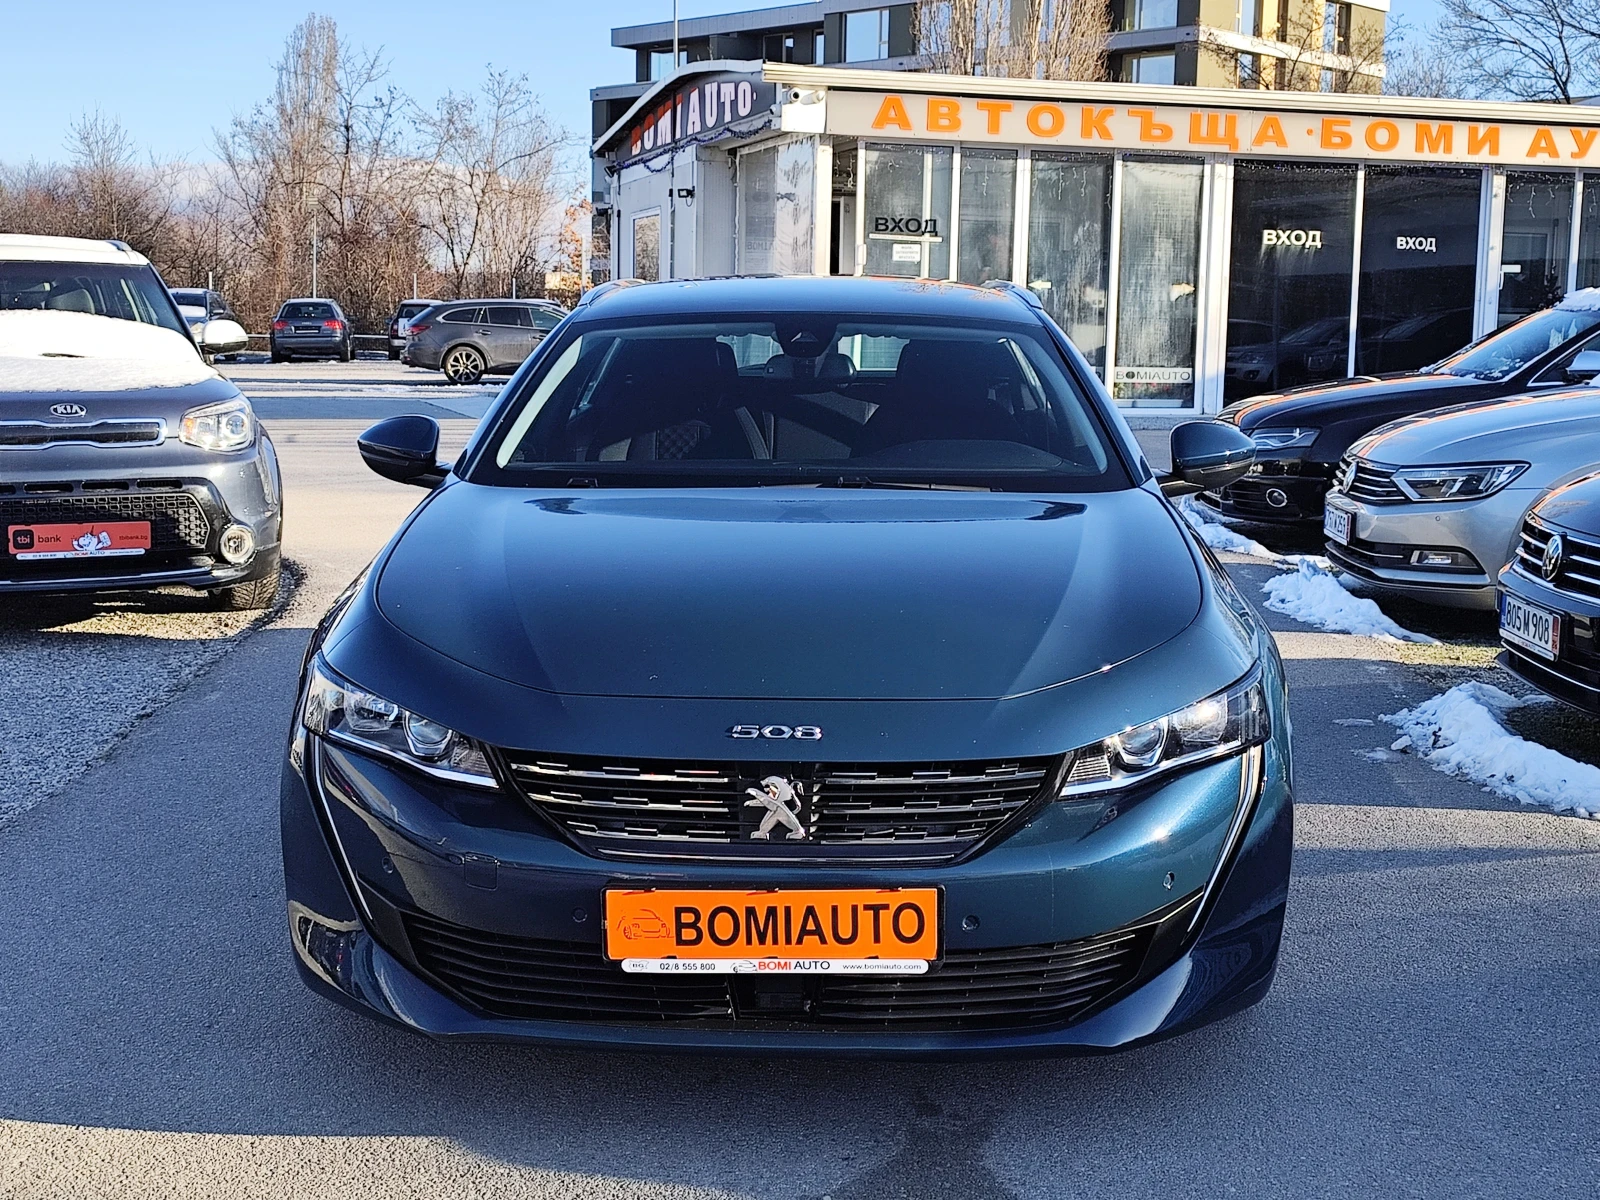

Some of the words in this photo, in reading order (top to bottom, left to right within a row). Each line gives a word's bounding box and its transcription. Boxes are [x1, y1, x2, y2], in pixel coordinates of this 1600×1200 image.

[1320, 117, 1501, 156] БОМИ
[875, 217, 938, 236] ВХОД
[1262, 229, 1323, 249] ВХОД
[1396, 236, 1437, 253] ВХОД
[1115, 370, 1191, 381] BOMIAUTO
[56, 404, 84, 415] KIA
[16, 534, 31, 544] tbi
[37, 534, 62, 543] bank
[1506, 601, 1522, 632] 805
[1523, 608, 1531, 637] M
[1531, 612, 1550, 645] 908
[732, 724, 822, 740] 508
[674, 902, 926, 947] BOMIAUTO
[659, 962, 680, 971] 02/8
[682, 962, 698, 970] 555
[699, 962, 716, 970] 800
[758, 961, 792, 971] BOMI
[793, 960, 831, 970] AUTO
